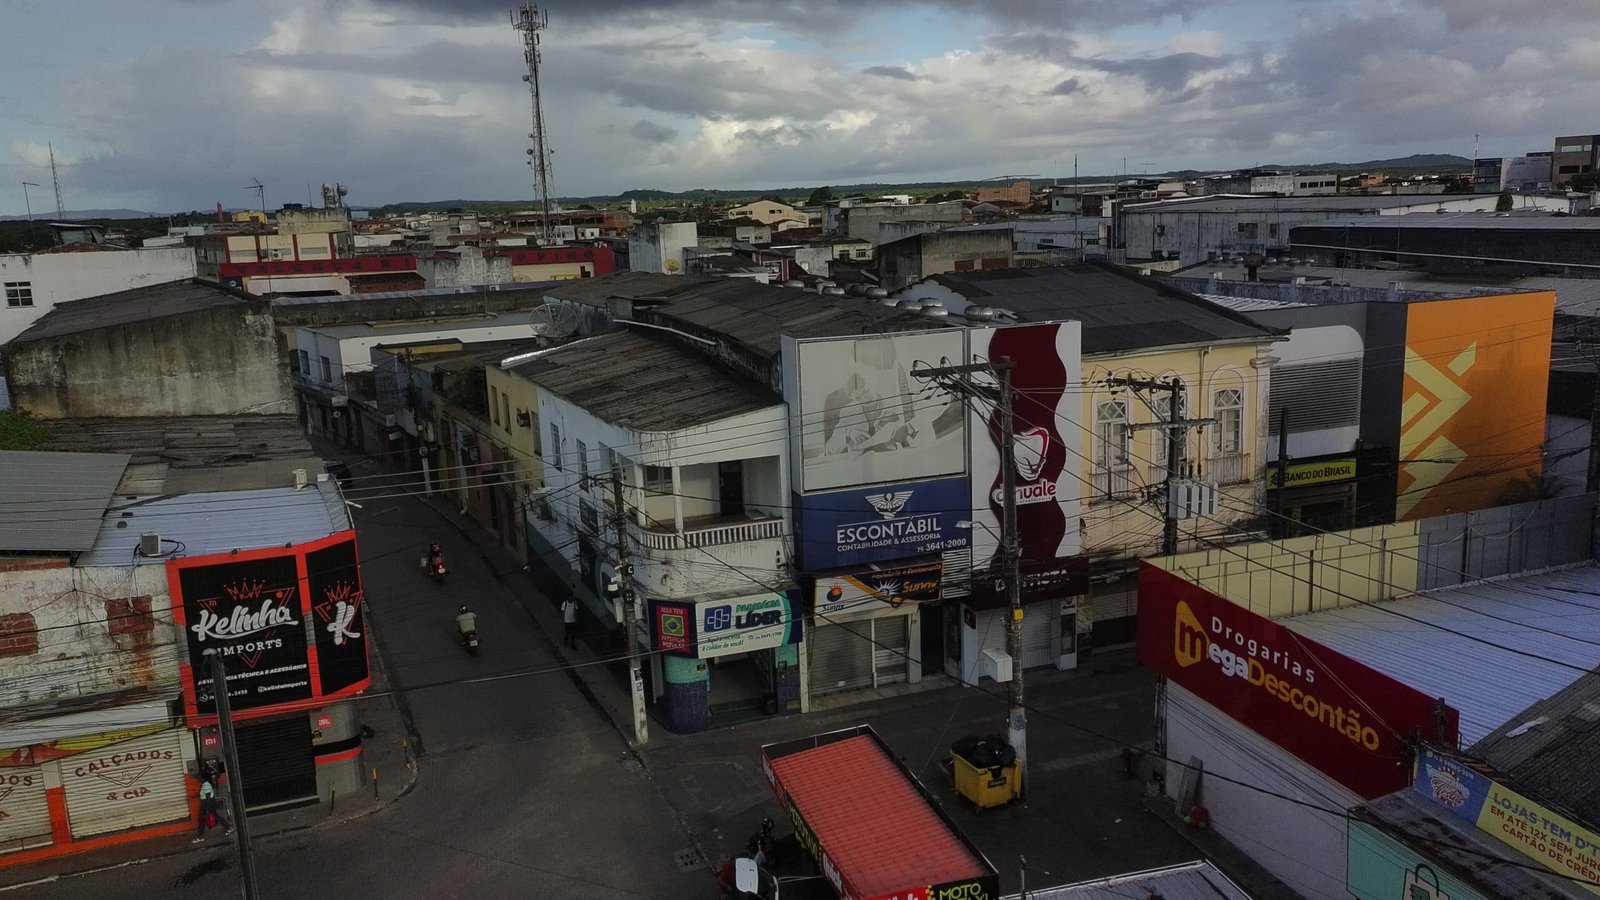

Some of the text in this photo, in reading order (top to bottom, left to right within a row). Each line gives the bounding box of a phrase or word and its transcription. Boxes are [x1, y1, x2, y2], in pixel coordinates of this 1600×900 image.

[1285, 465, 1351, 482] BANCO DO BRASIL
[836, 516, 942, 545] ESCONTÁBIL
[837, 532, 941, 552] CONTABILIDADE & ASSESSORIA
[925, 538, 967, 552] 3641-2000
[901, 580, 938, 594] Sunny
[191, 598, 299, 642] Kelinha
[735, 610, 782, 629] LÍDER
[1211, 615, 1315, 684] Drogarias
[237, 670, 264, 680] TÉCNICA
[269, 663, 307, 675] ACESSÓRIOS
[75, 750, 174, 777] CALÇADOS
[106, 787, 151, 801] & CIA
[1493, 793, 1537, 824] LOJAS
[1541, 817, 1571, 843] TEM
[1490, 805, 1506, 819] EM
[1507, 816, 1527, 831] ATÉ
[1529, 826, 1548, 843] 12X
[1549, 837, 1573, 857] SEM
[1502, 824, 1546, 853] CARTÃO
[1549, 850, 1563, 863] DE
